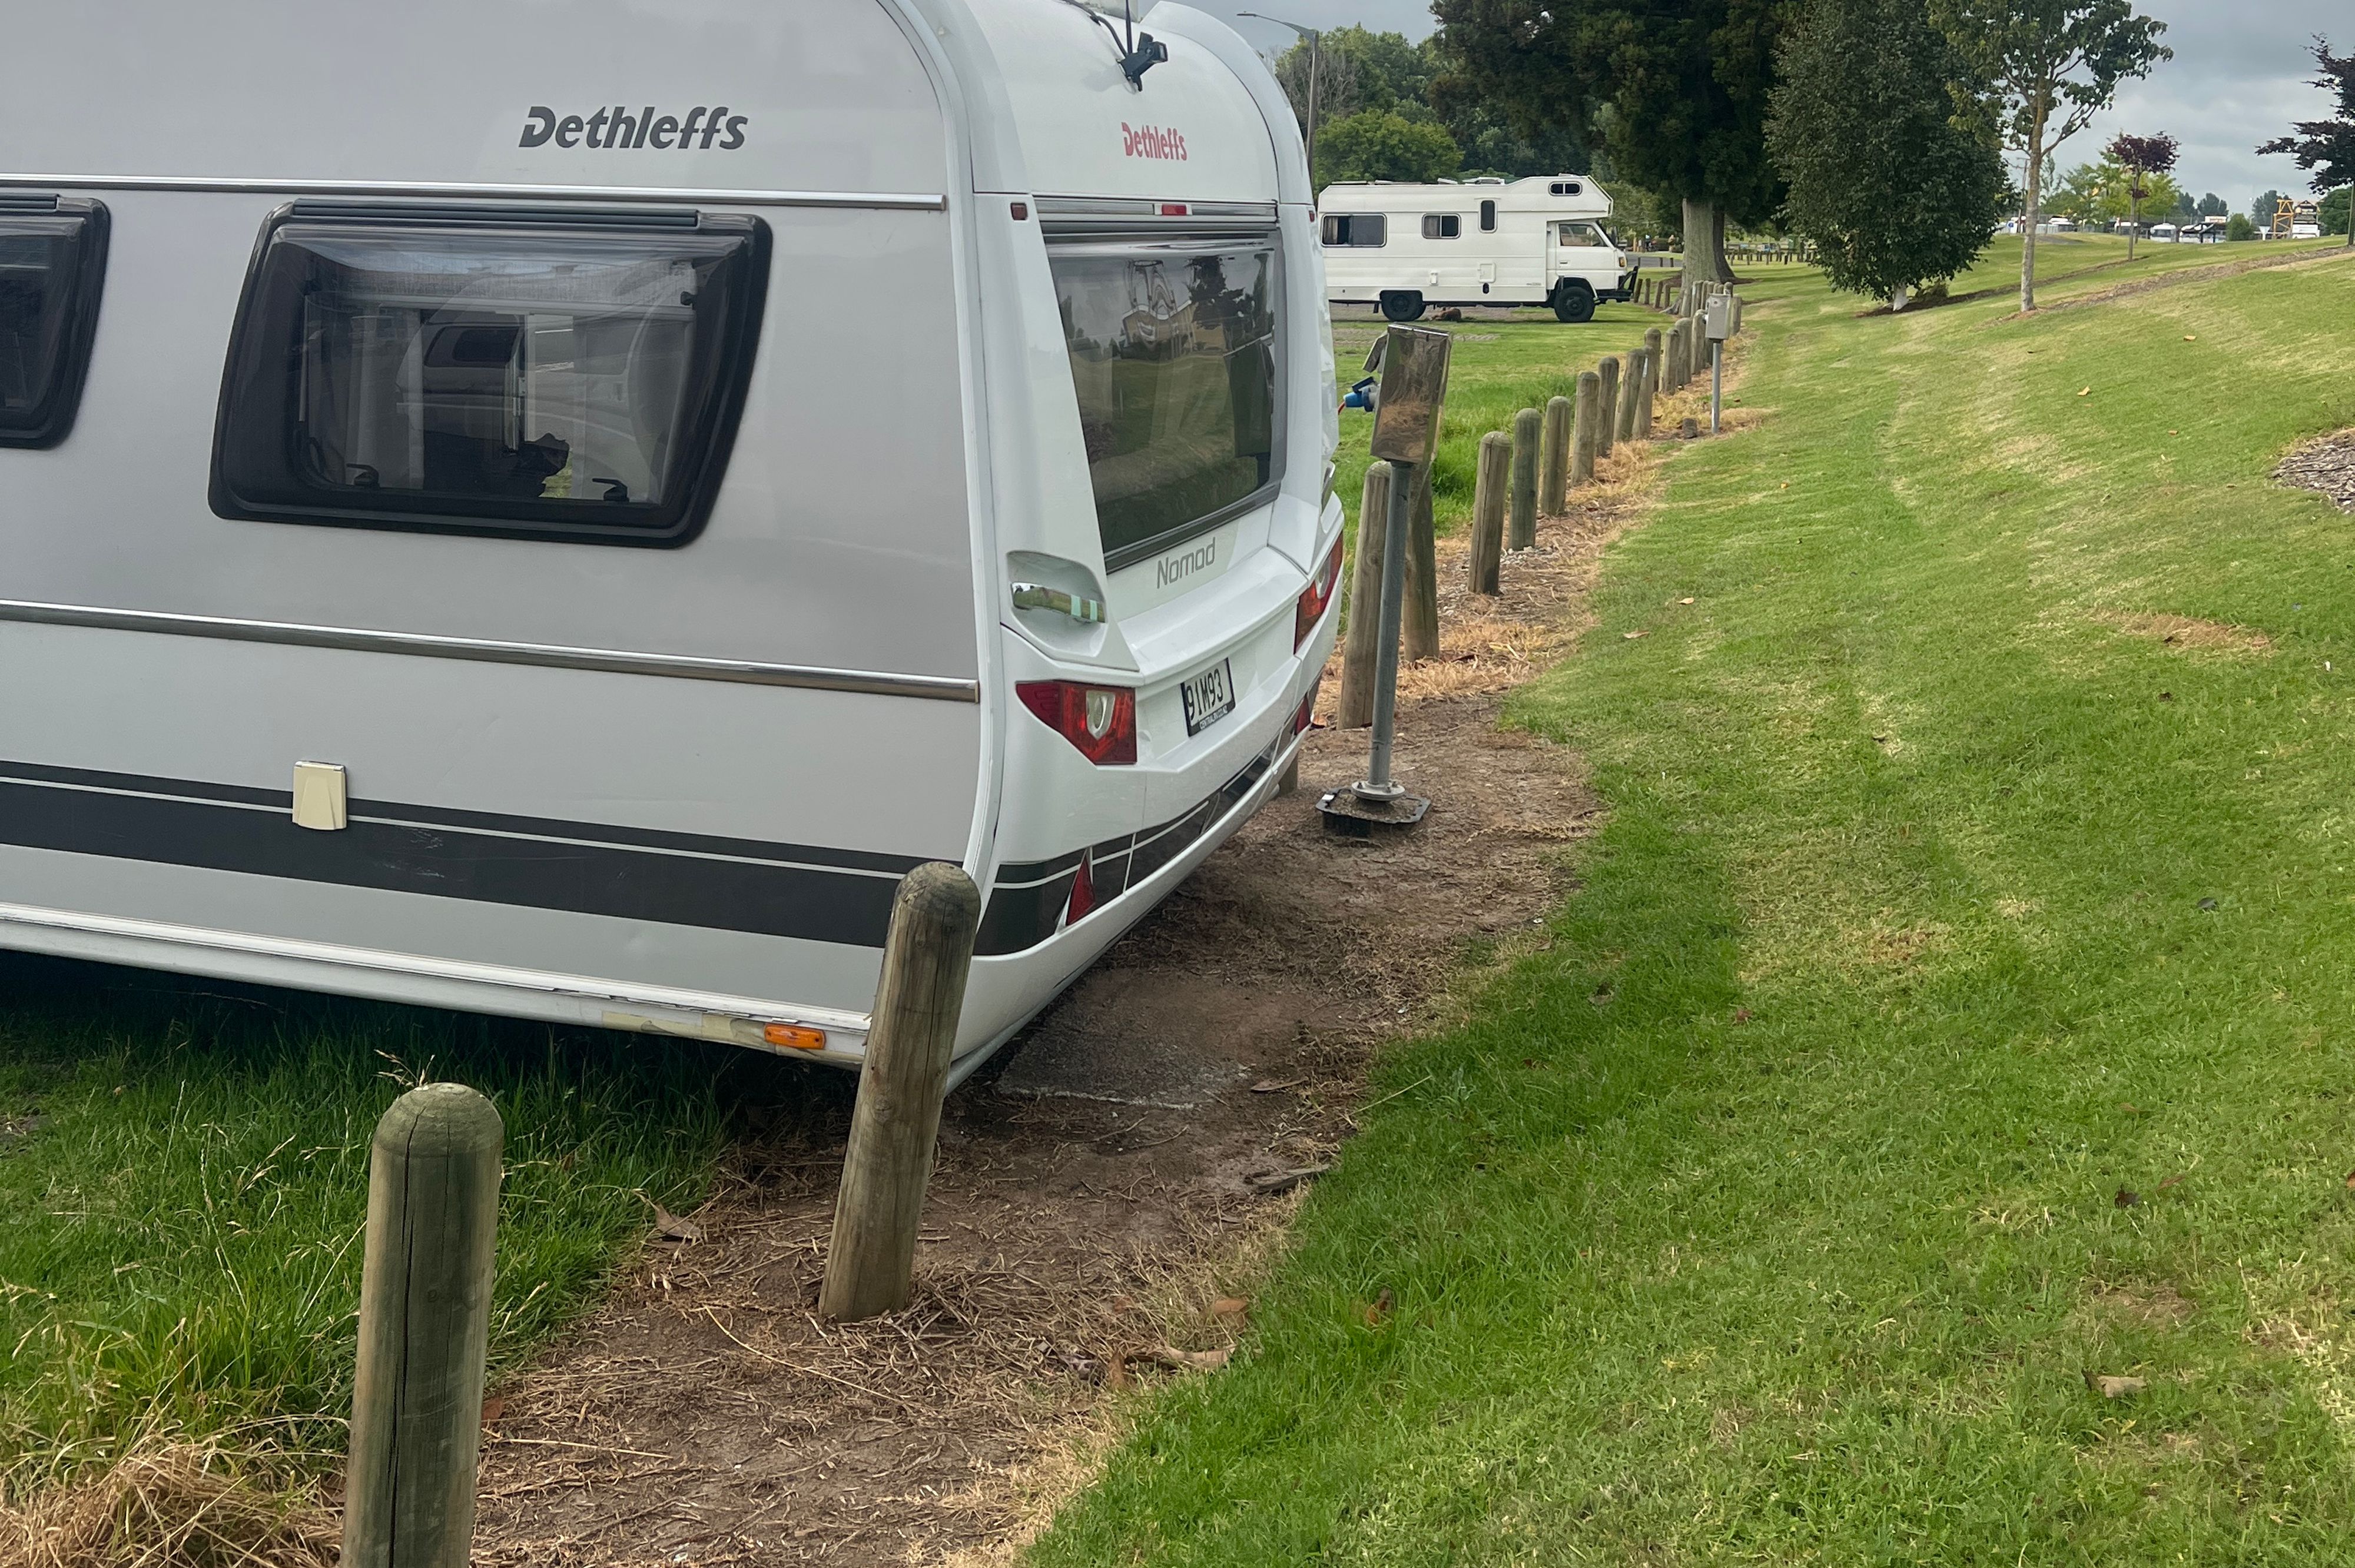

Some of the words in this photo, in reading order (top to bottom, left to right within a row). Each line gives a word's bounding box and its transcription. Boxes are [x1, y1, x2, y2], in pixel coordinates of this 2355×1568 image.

[519, 106, 748, 150] Dethleffs
[1121, 122, 1187, 161] Dethleffs
[1157, 536, 1215, 589] Nomad
